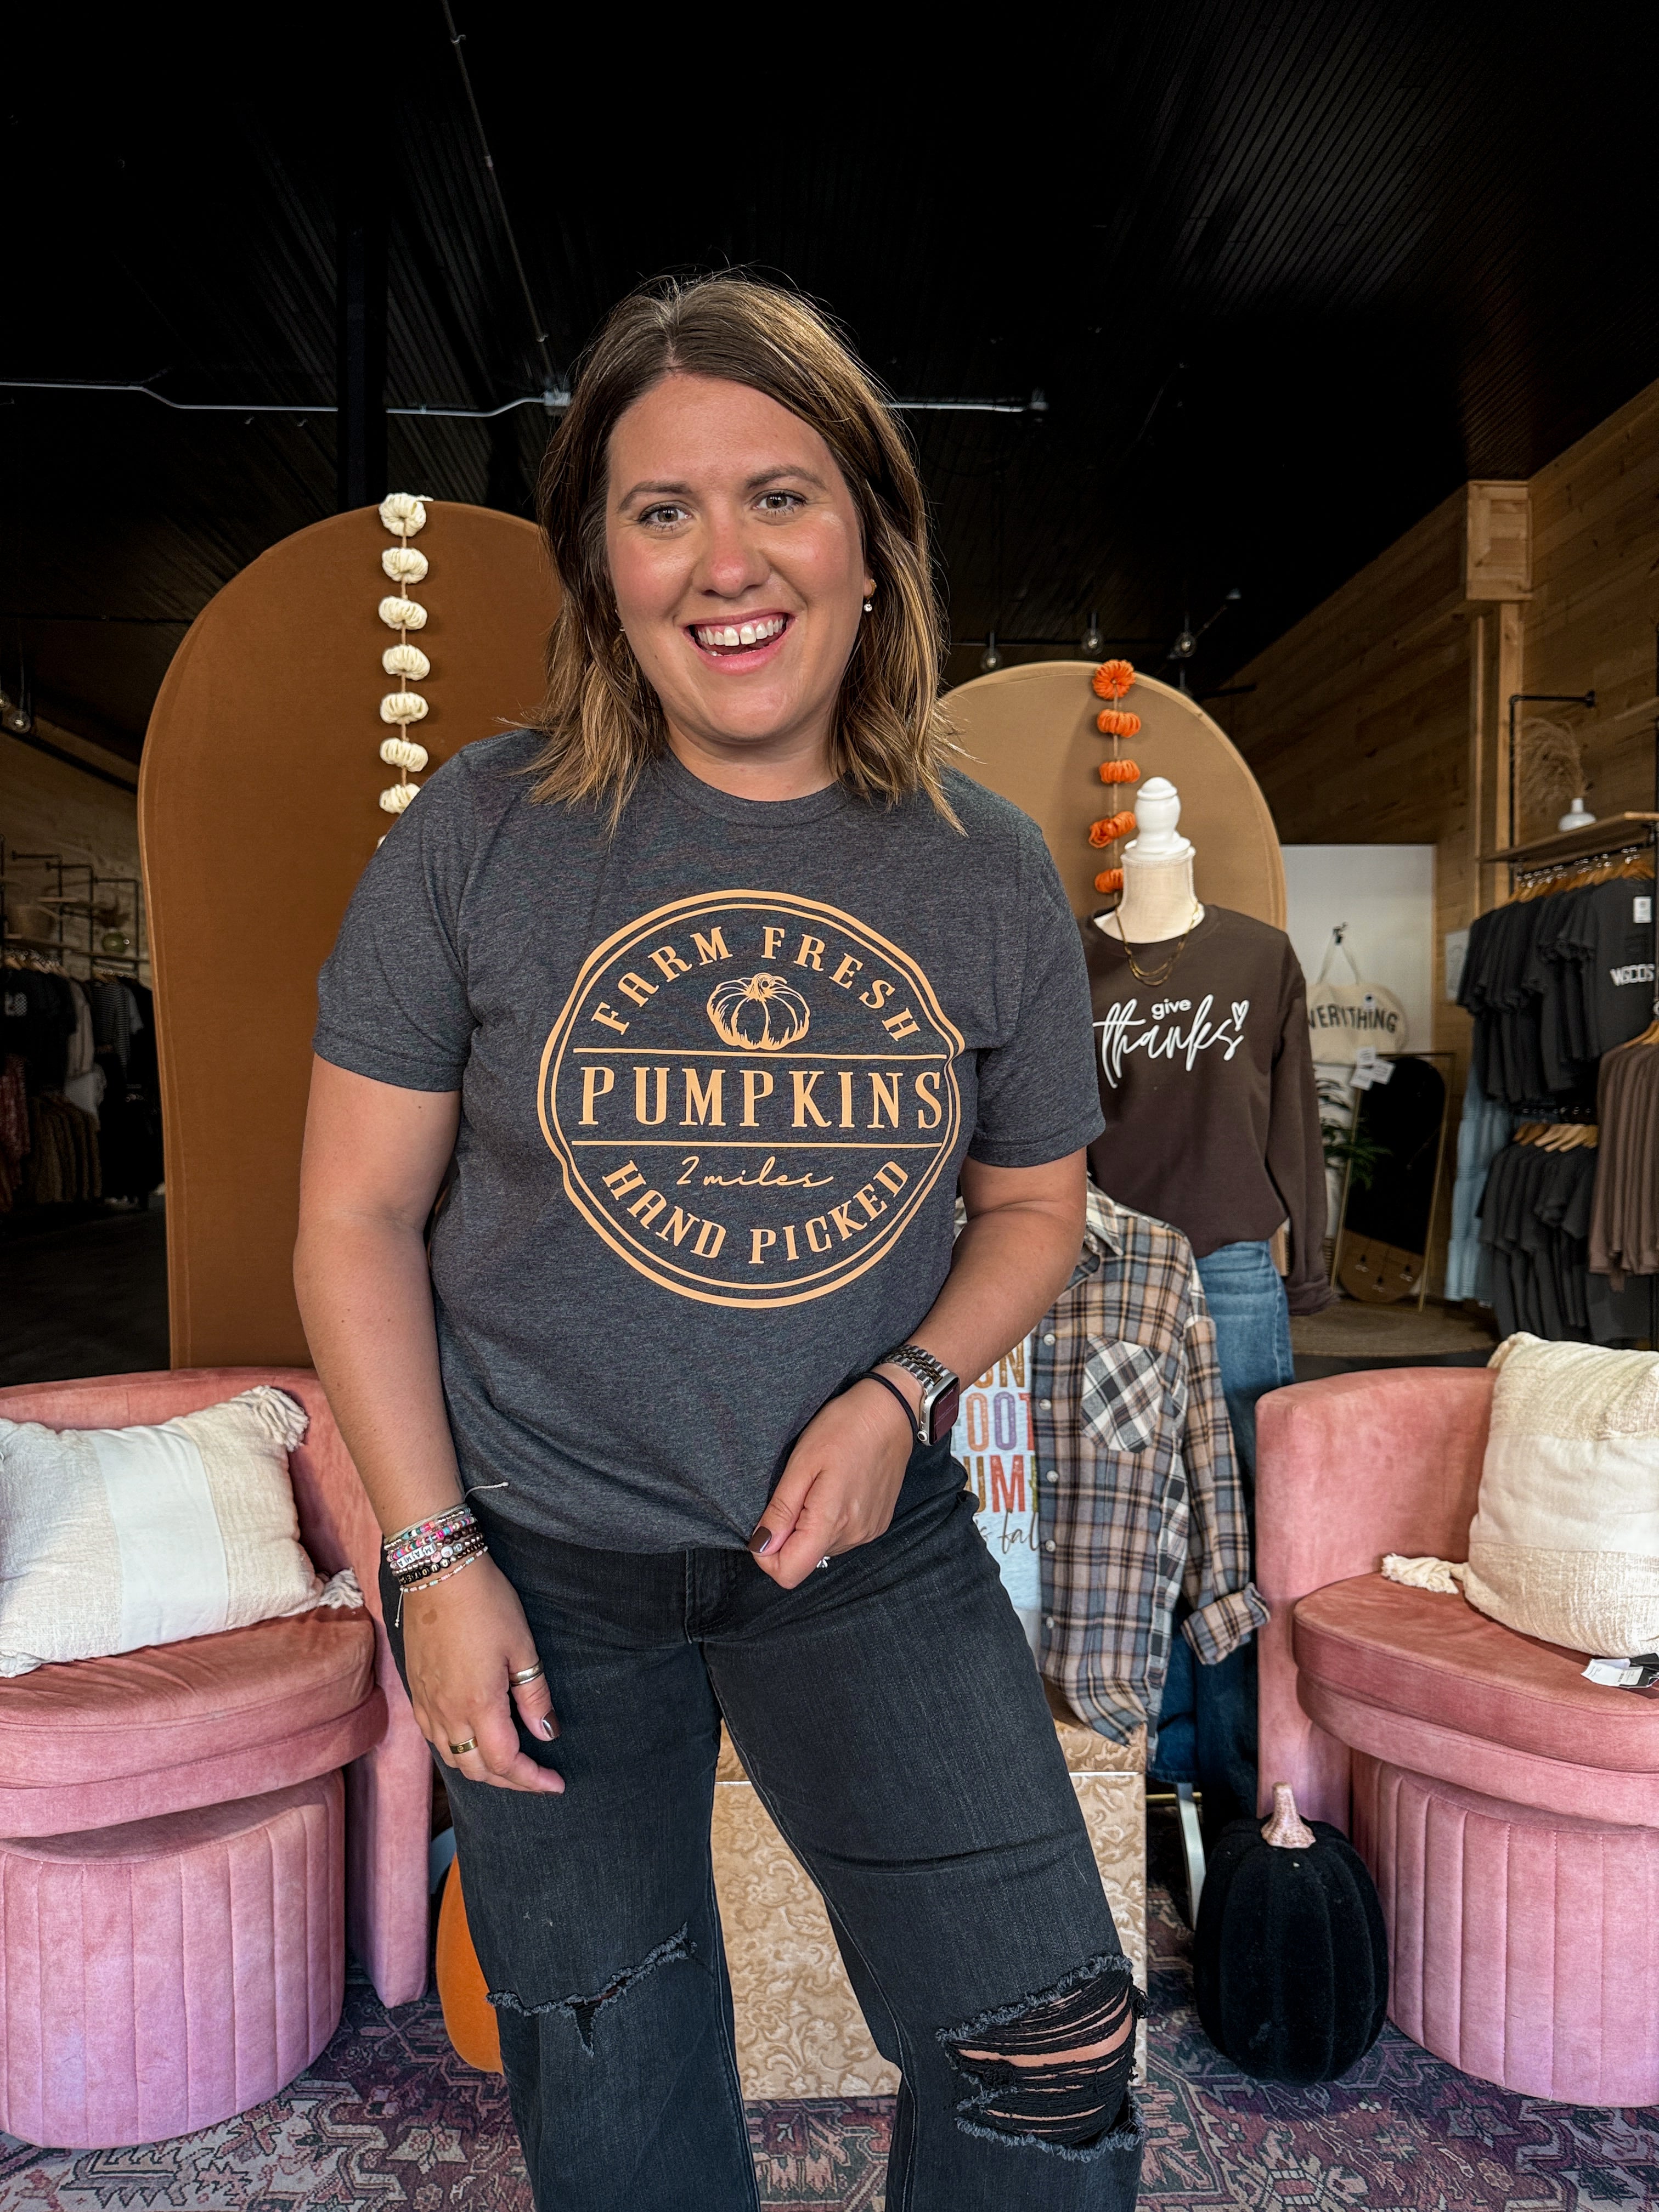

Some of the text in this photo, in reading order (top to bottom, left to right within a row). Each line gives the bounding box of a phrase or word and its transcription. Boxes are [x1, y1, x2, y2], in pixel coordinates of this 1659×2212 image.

[591, 926, 922, 1042] FARM FRESH
[1150, 998, 1193, 1020] give
[1092, 994, 1244, 1089] thanks
[578, 1066, 943, 1130] PUMPKINS
[703, 1156, 834, 1189] miles
[602, 1160, 910, 1265] HAND PICKED
